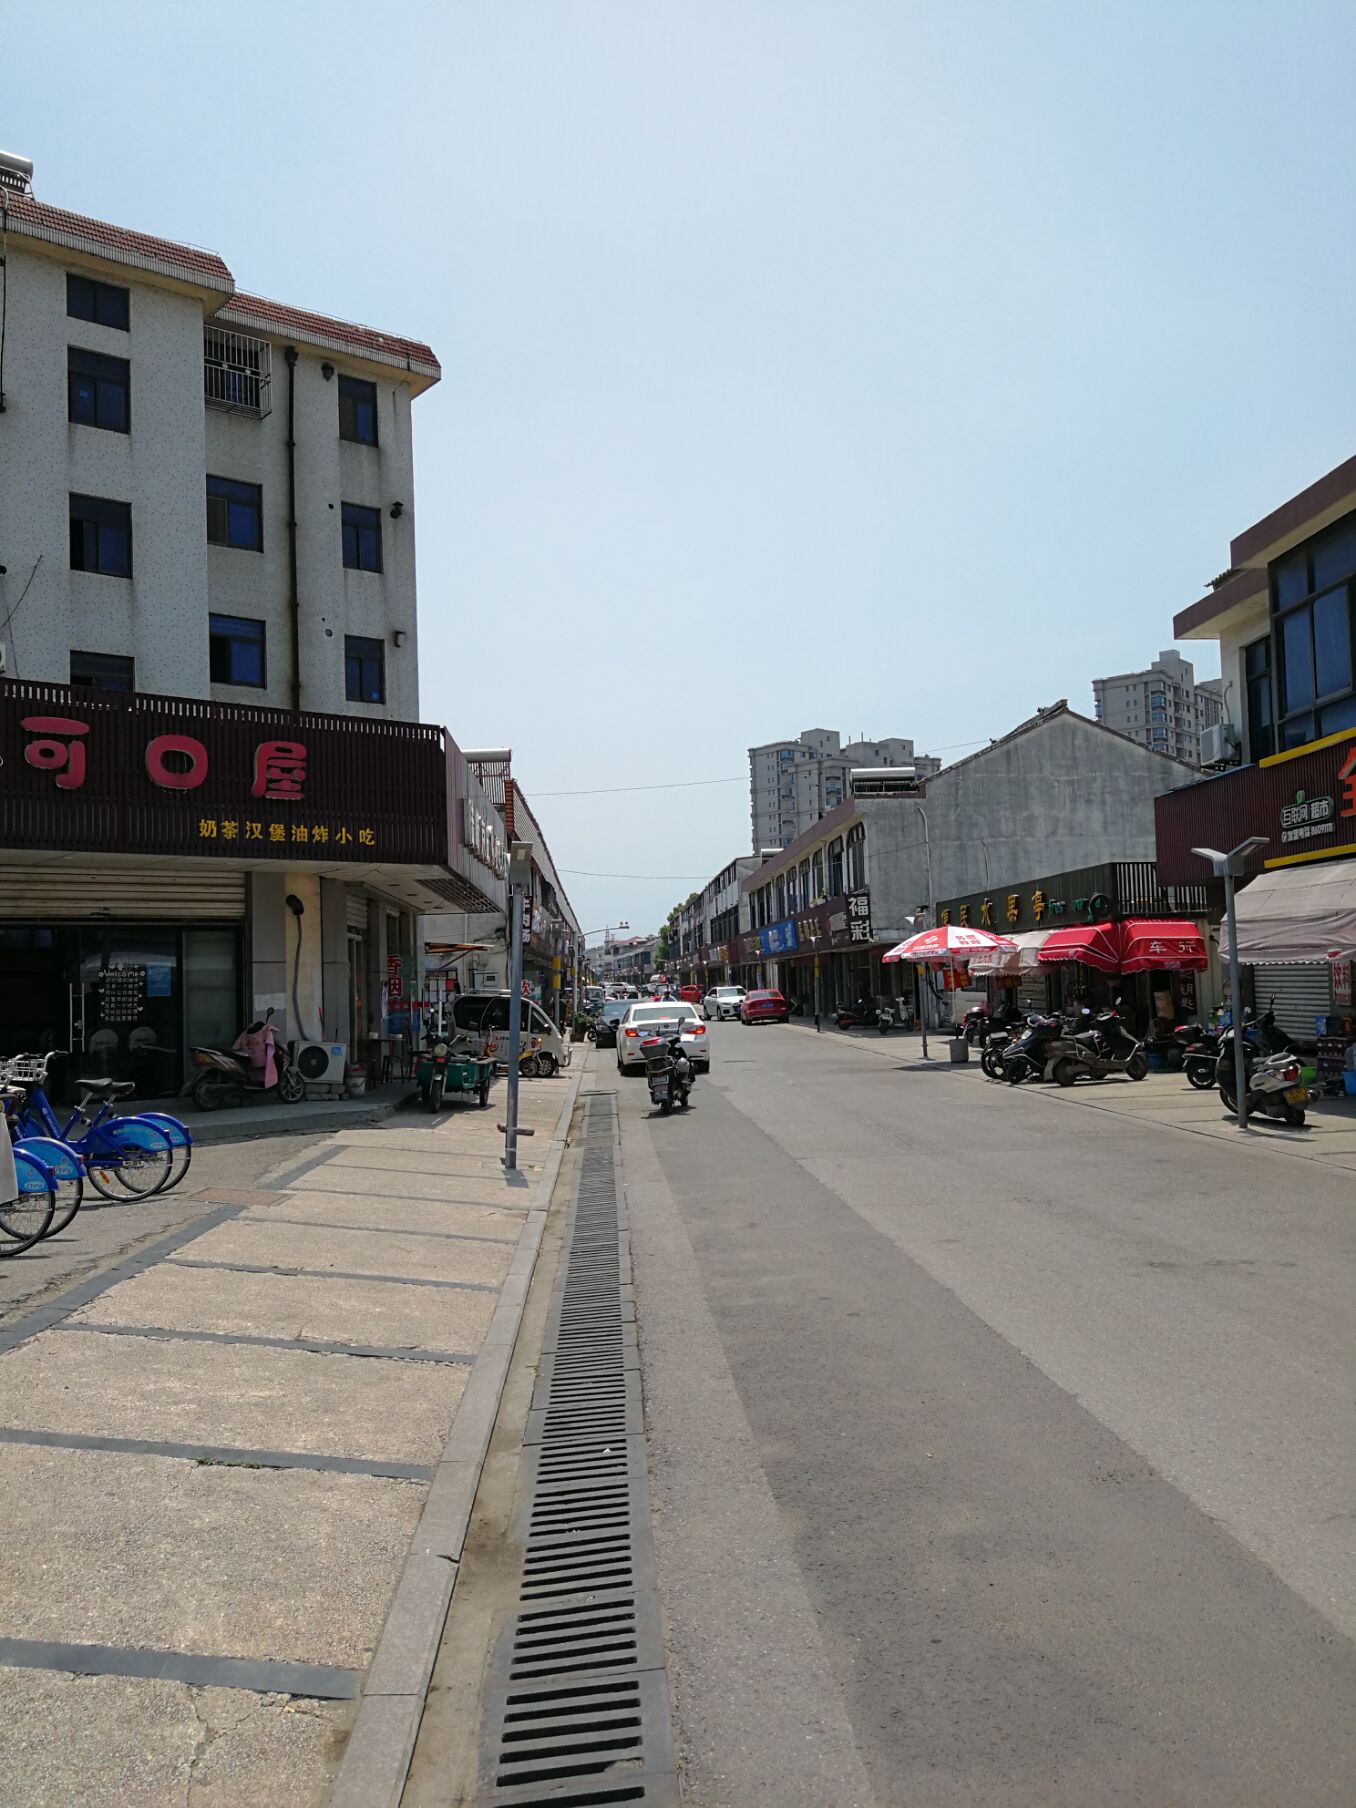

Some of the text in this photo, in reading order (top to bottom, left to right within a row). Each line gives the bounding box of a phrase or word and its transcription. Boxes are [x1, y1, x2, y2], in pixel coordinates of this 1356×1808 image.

[20, 716, 307, 800] 可口屋
[1282, 800, 1329, 826] 互联网 超市
[199, 819, 375, 846] 奶茶汉堡油炸小吃
[849, 896, 871, 942] 福彩
[1149, 941, 1196, 954] 车行
